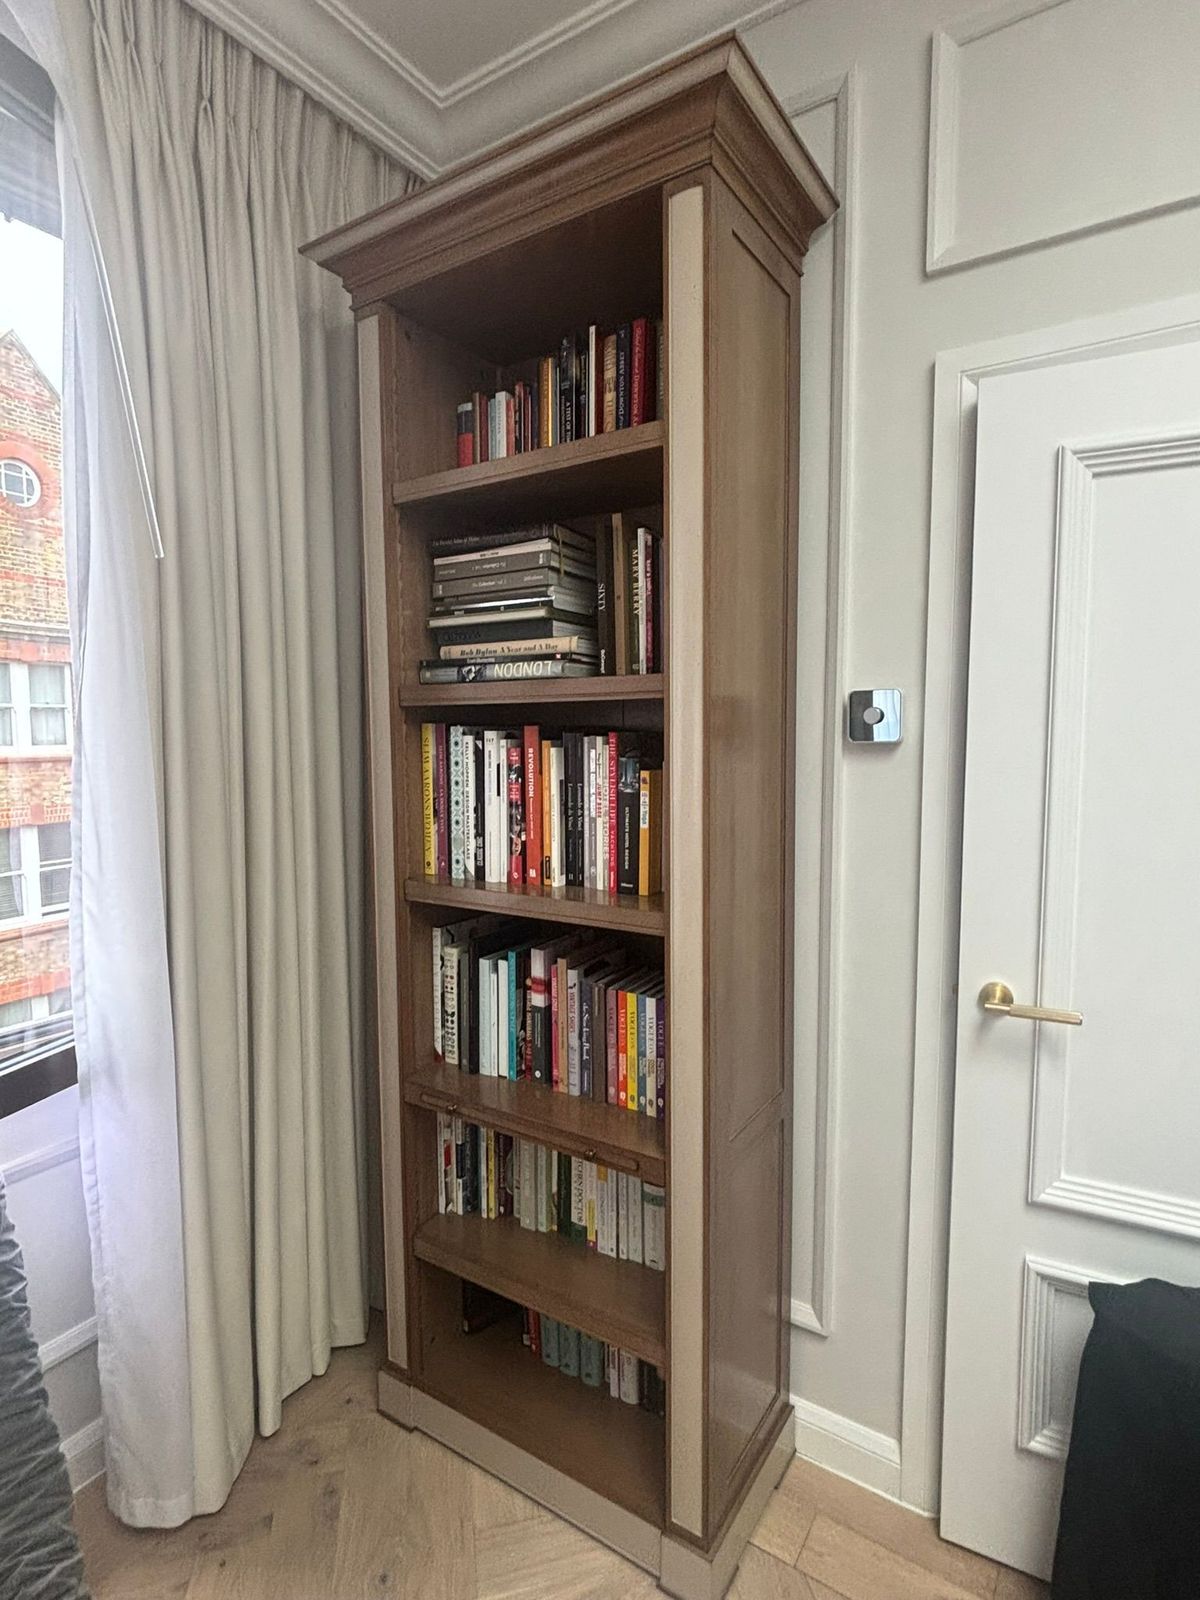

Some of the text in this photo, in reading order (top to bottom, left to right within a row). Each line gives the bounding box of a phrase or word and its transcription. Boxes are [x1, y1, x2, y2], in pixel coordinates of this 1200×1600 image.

[632, 549, 643, 615] MARY BERRY
[598, 583, 606, 611] SIXTY
[475, 648, 497, 656] Dylan
[500, 646, 506, 654] A
[506, 645, 522, 653] Year
[545, 643, 558, 651] Day
[494, 660, 552, 677] LONDON
[424, 768, 432, 811] AARONS
[609, 759, 617, 801] STYLISH
[609, 803, 617, 825] LIFE
[648, 1017, 656, 1043] VOGUE
[657, 1020, 665, 1046] VOGUE
